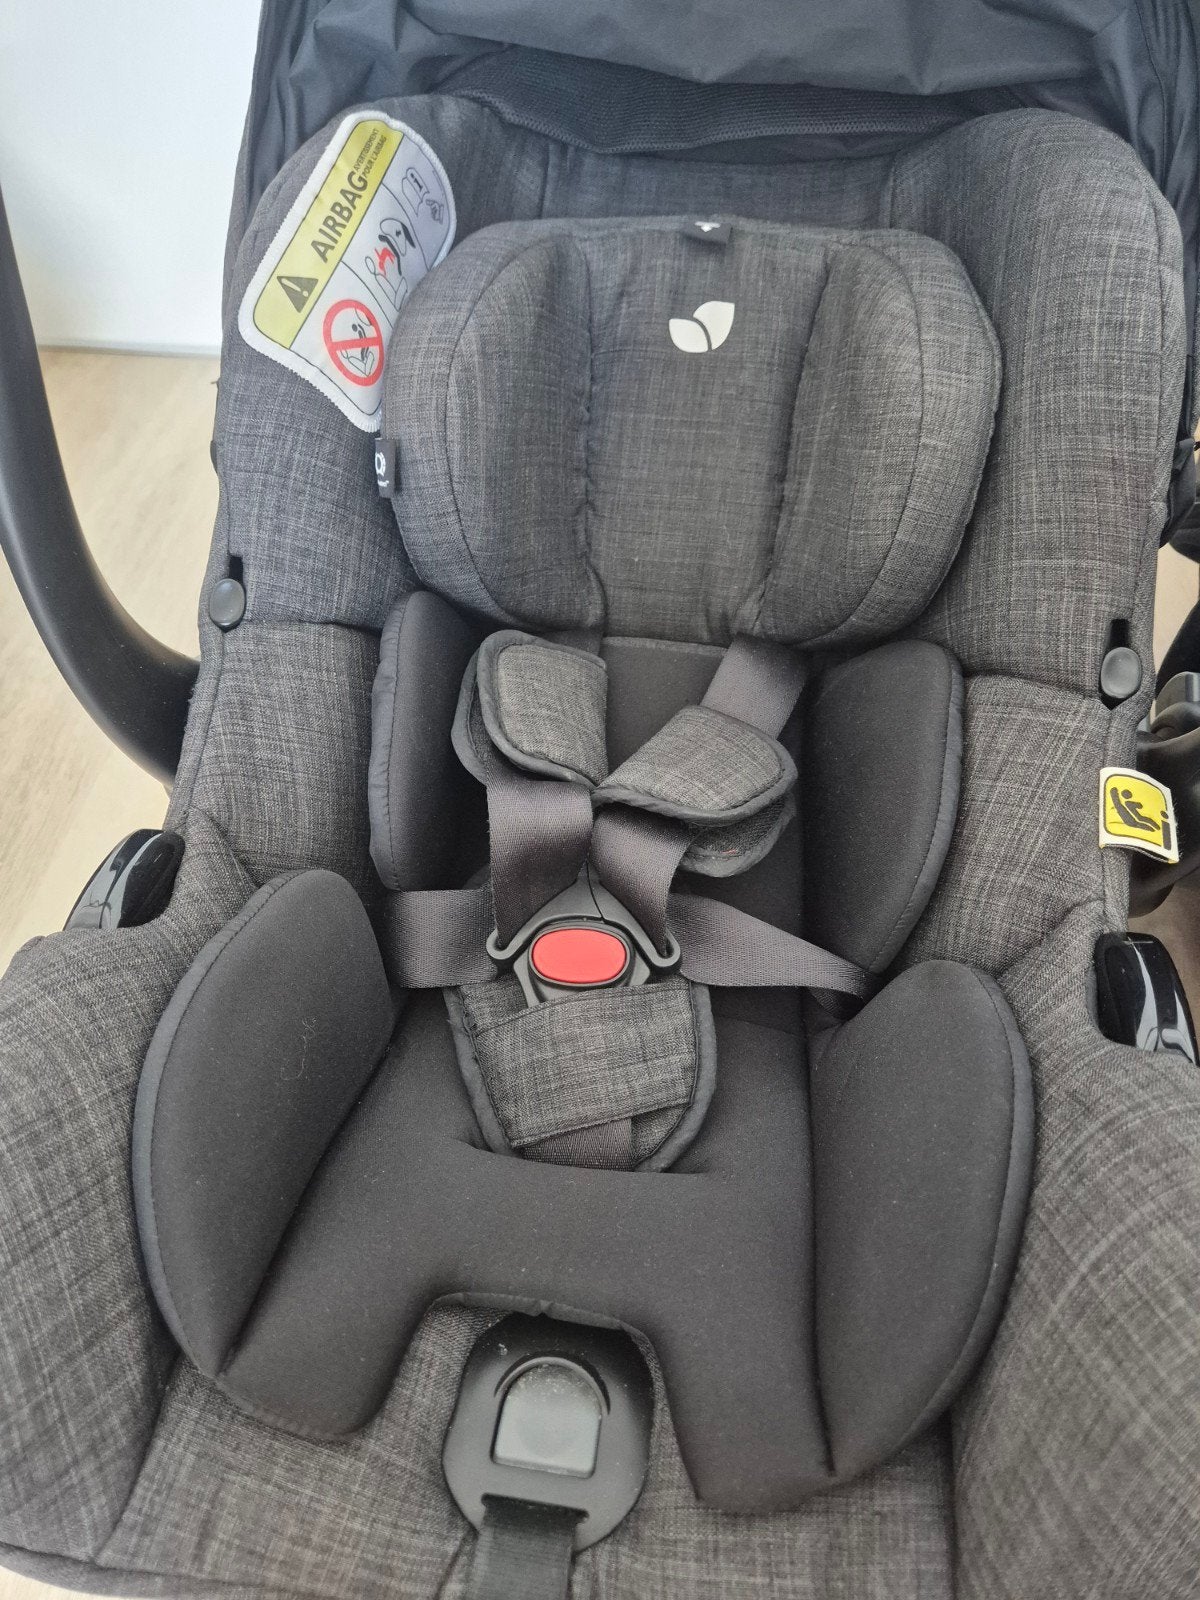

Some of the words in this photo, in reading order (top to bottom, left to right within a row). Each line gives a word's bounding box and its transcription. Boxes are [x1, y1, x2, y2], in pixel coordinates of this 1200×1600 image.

[354, 128, 379, 172] AVERTISSEMENT
[362, 158, 374, 178] POUR
[310, 170, 368, 263] AIRBAG
